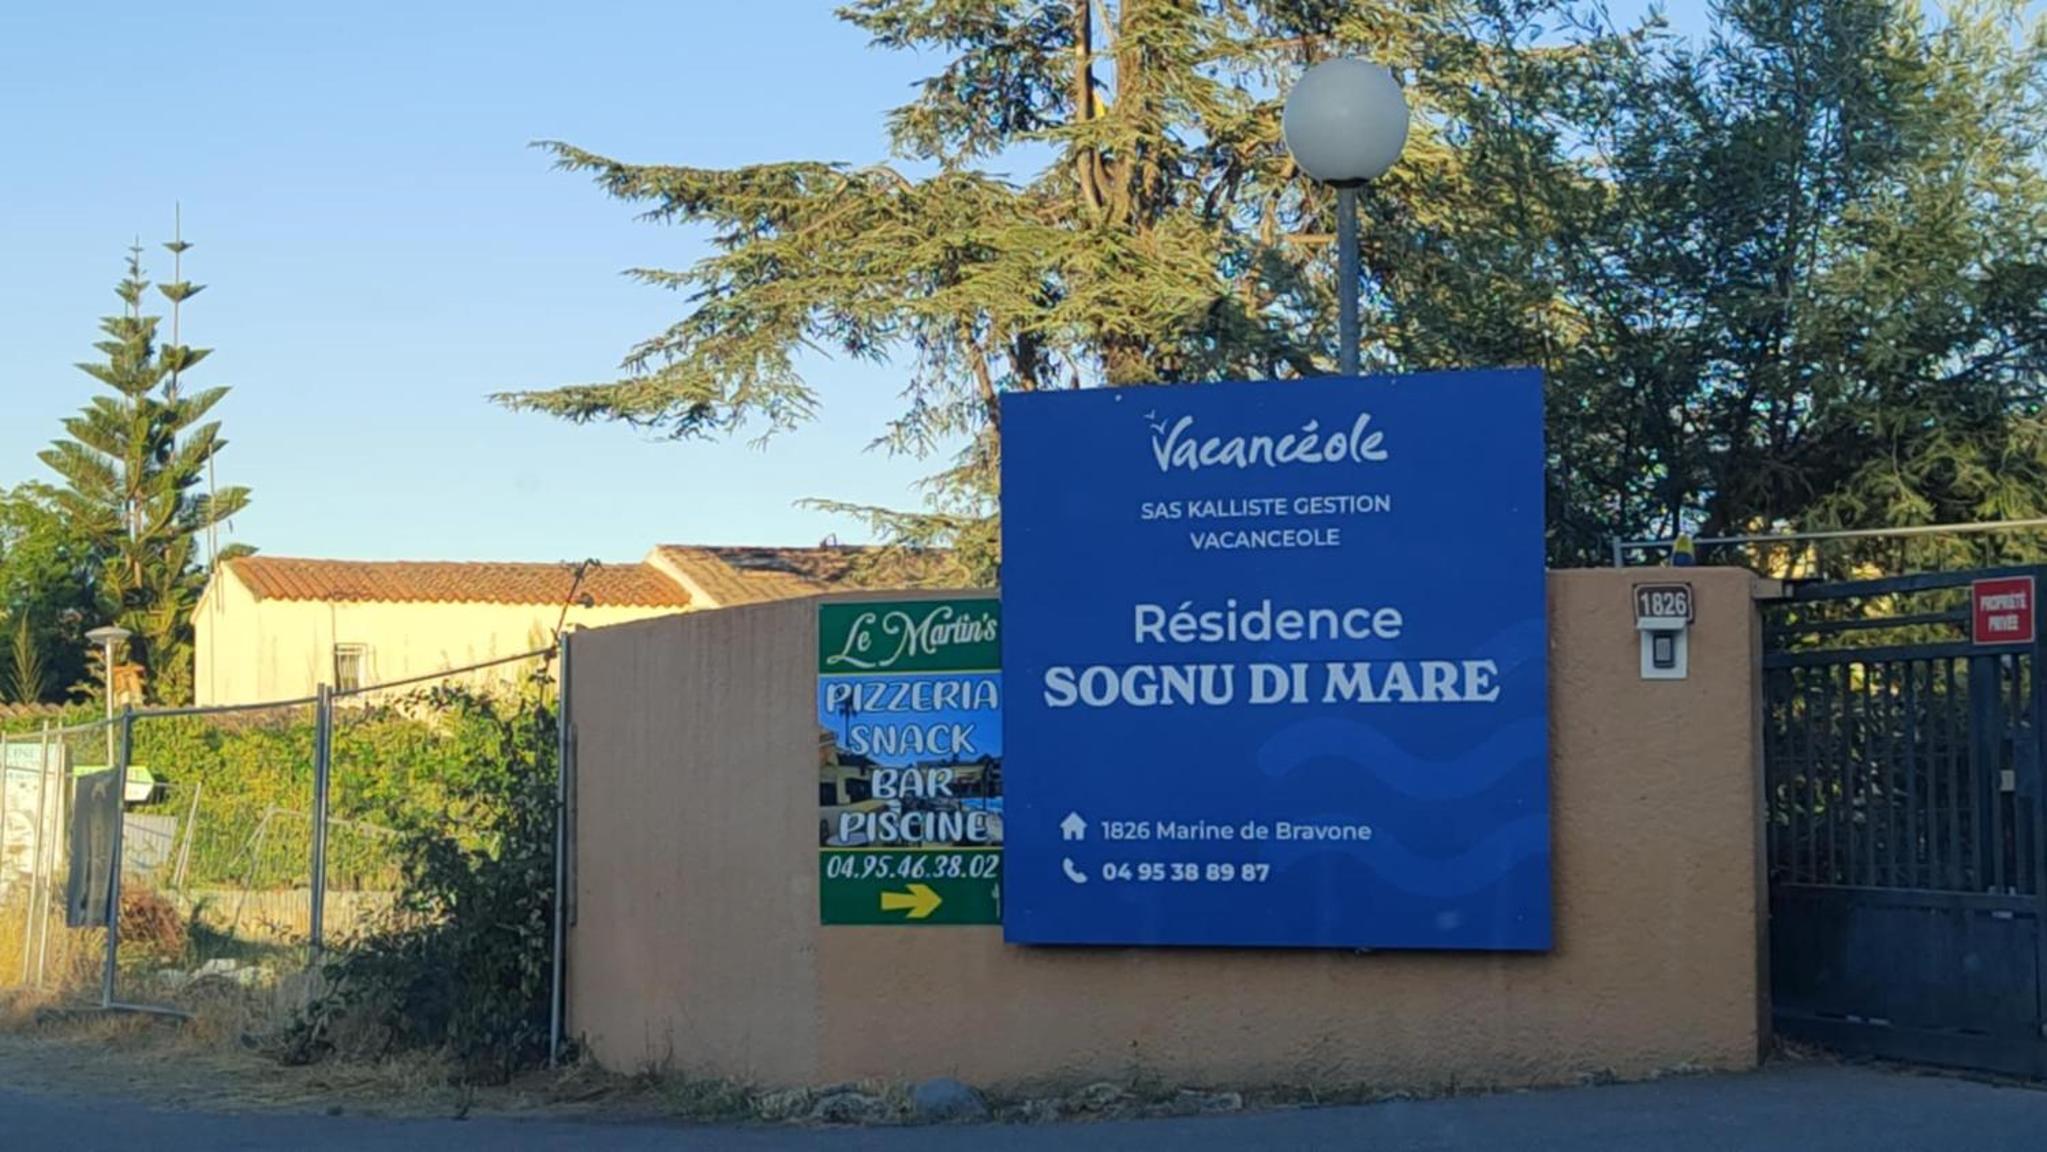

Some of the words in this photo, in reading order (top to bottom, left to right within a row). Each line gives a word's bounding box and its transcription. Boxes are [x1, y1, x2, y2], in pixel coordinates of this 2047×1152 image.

[1152, 412, 1389, 472] Vacancéole
[1141, 501, 1182, 520] SAS
[1187, 497, 1288, 519] KALLISTE
[1293, 494, 1391, 515] GESTION
[1189, 528, 1340, 550] VACANCEOLE
[1640, 592, 1688, 616] 1826
[826, 612, 877, 668] Le
[878, 605, 998, 667] Martin's
[1135, 600, 1403, 643] Résidence
[826, 679, 999, 713] PIZZERIA
[1044, 664, 1235, 707] SOGNU
[1248, 663, 1309, 704] DI
[1322, 659, 1500, 703] MARE
[850, 723, 976, 755] SNACK
[871, 767, 953, 799] BAR
[839, 811, 989, 842] PISCINE
[1101, 821, 1151, 840] 1826
[1156, 820, 1235, 840] Marine
[1239, 820, 1269, 840] de
[1275, 821, 1372, 841] Bravone
[826, 854, 999, 879] 04.95.46.38.02
[1102, 862, 1133, 882] 04
[1137, 862, 1166, 882] 95
[1170, 862, 1200, 882] 38
[1205, 862, 1236, 882] 89
[1241, 862, 1270, 882] 87
